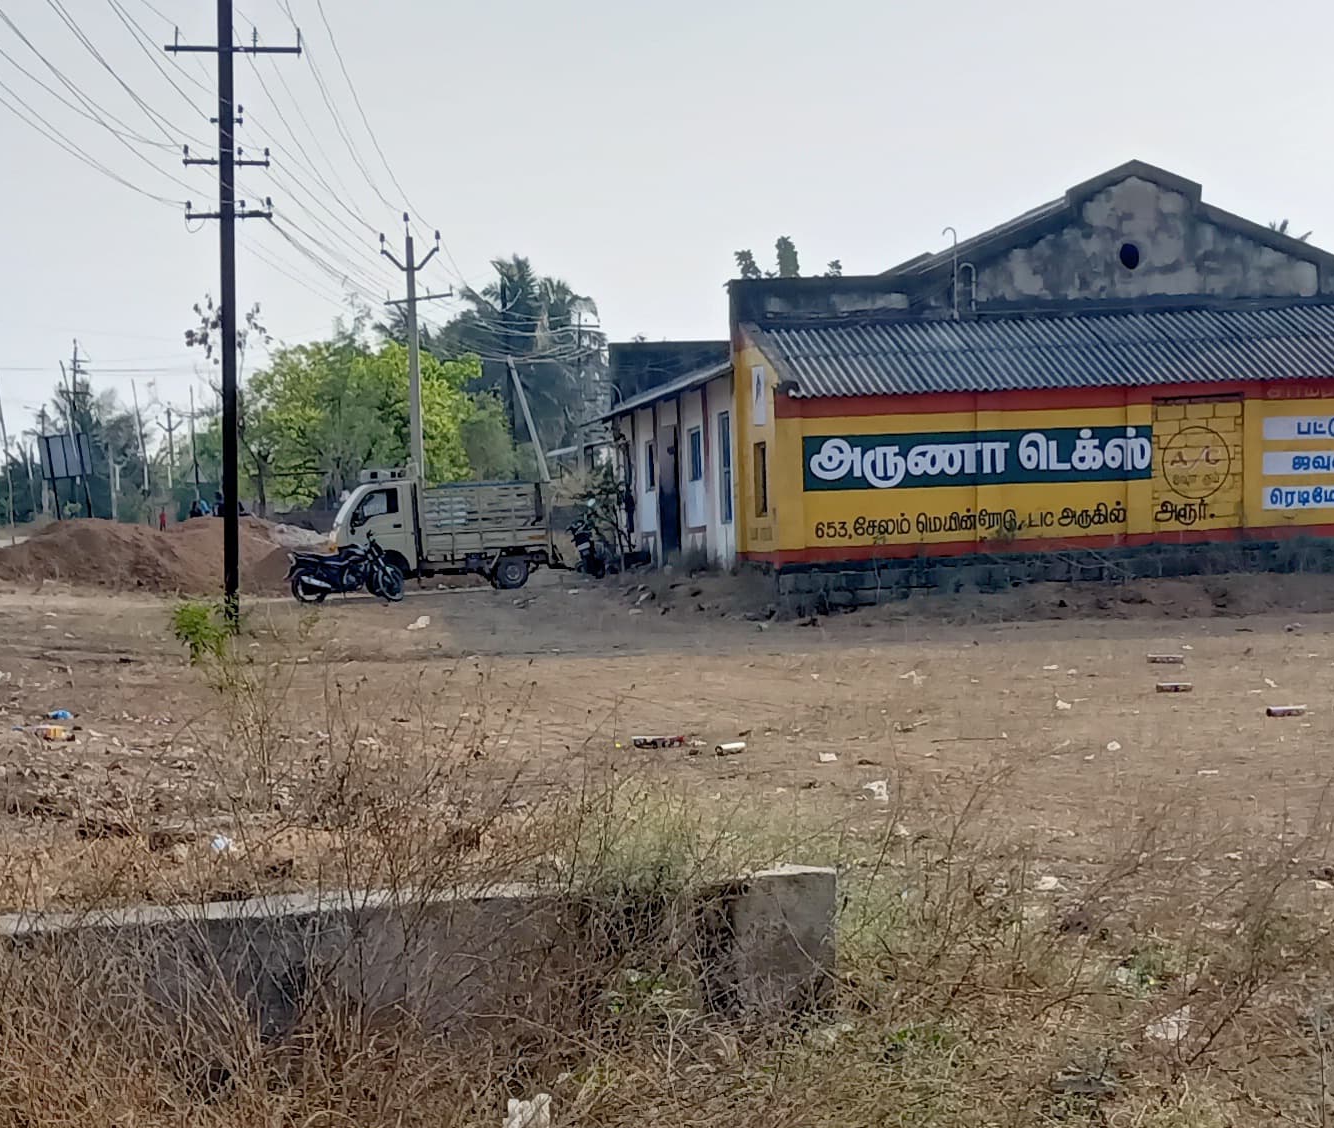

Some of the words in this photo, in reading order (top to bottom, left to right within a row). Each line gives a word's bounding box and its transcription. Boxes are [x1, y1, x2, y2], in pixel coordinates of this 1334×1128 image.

[809, 438, 1011, 488] அருணா
[1018, 426, 1152, 471] டெக்ஸ்
[1027, 511, 1055, 529] LIC
[1057, 501, 1127, 529] அருகில்
